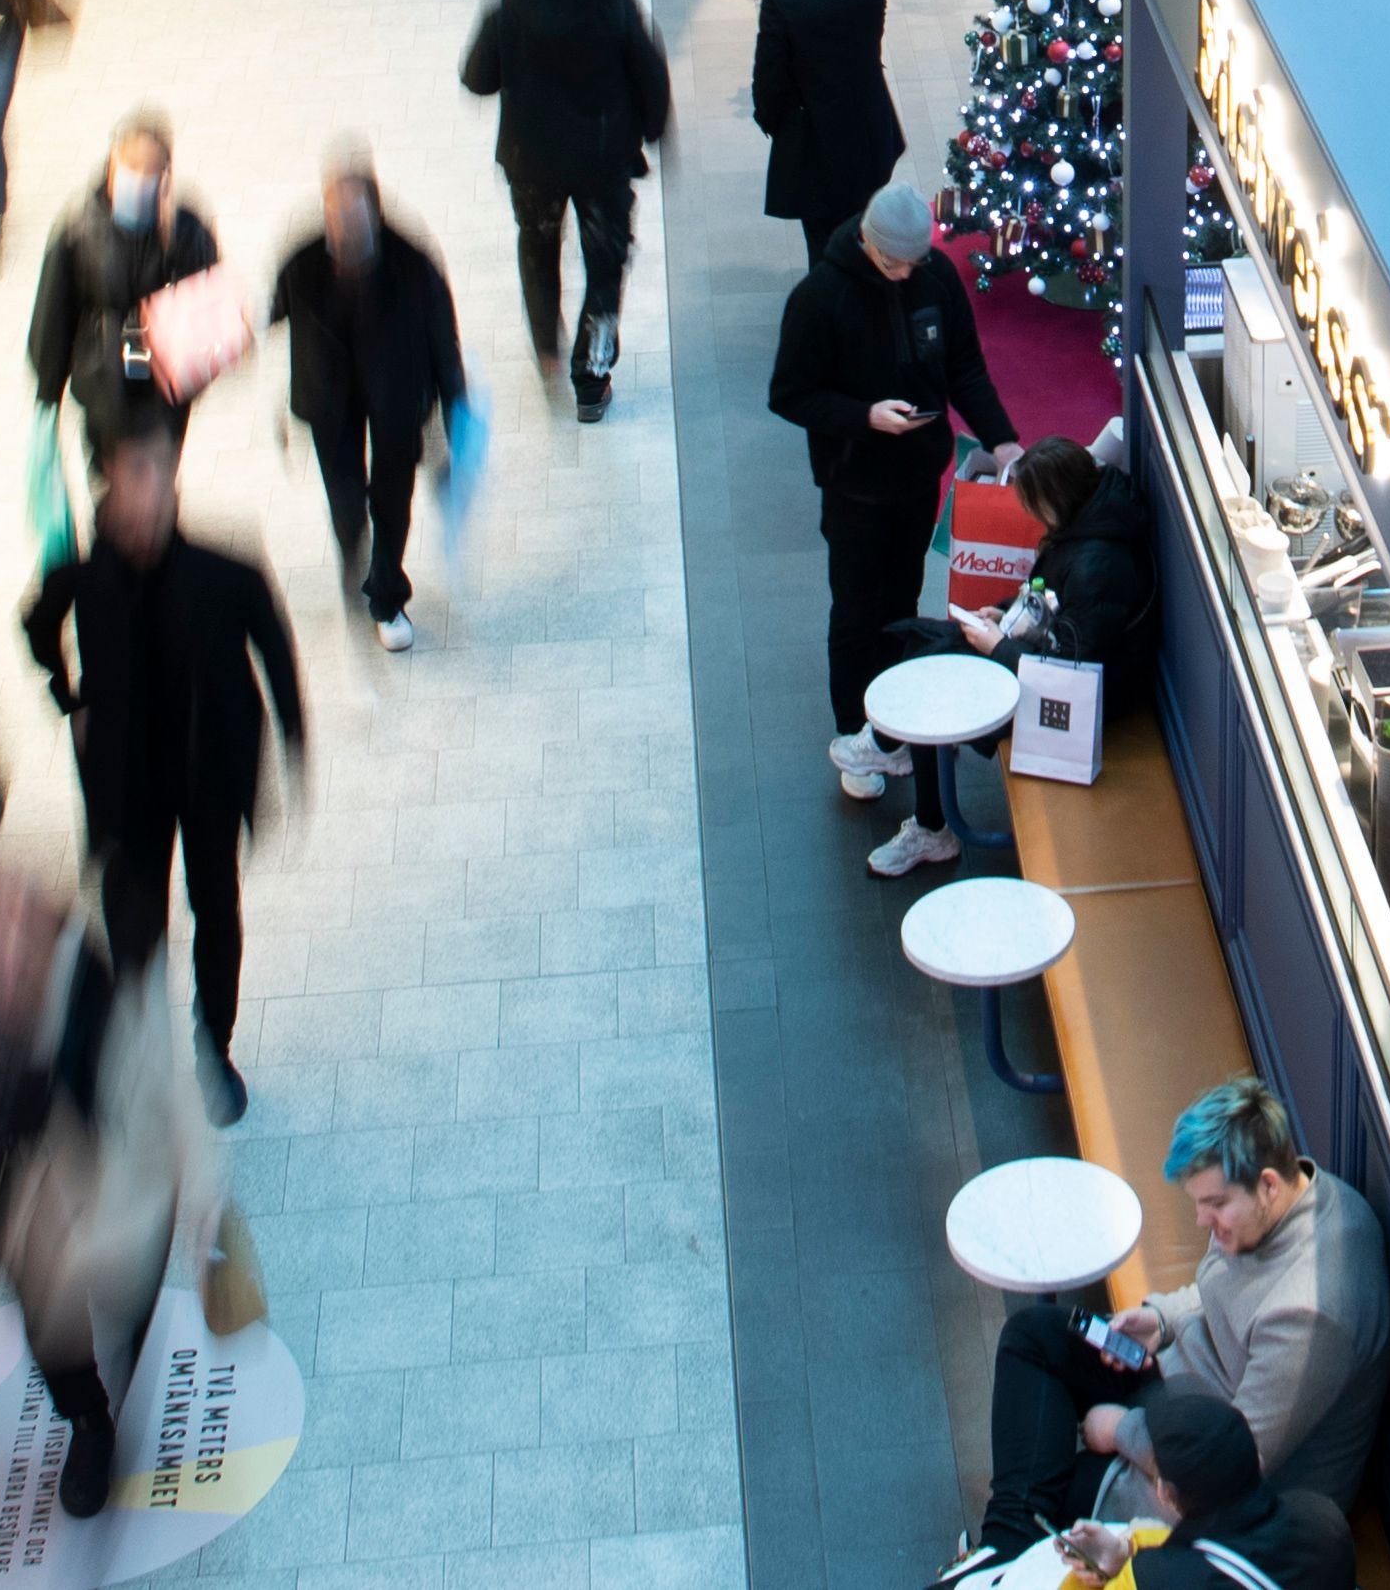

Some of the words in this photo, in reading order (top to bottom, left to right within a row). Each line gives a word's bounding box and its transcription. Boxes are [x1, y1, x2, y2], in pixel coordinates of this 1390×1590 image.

[952, 550, 1016, 575] Media
[210, 1363, 236, 1400] TVÅ
[13, 1424, 36, 1455] TILL
[41, 1426, 66, 1465] VISAR
[150, 1348, 199, 1509] OMTÄNKSAMHET
[195, 1402, 232, 1485] METERS
[3, 1456, 30, 1503] ANDRA
[29, 1469, 59, 1534] OMTANKE
[22, 1537, 46, 1568] OCH
